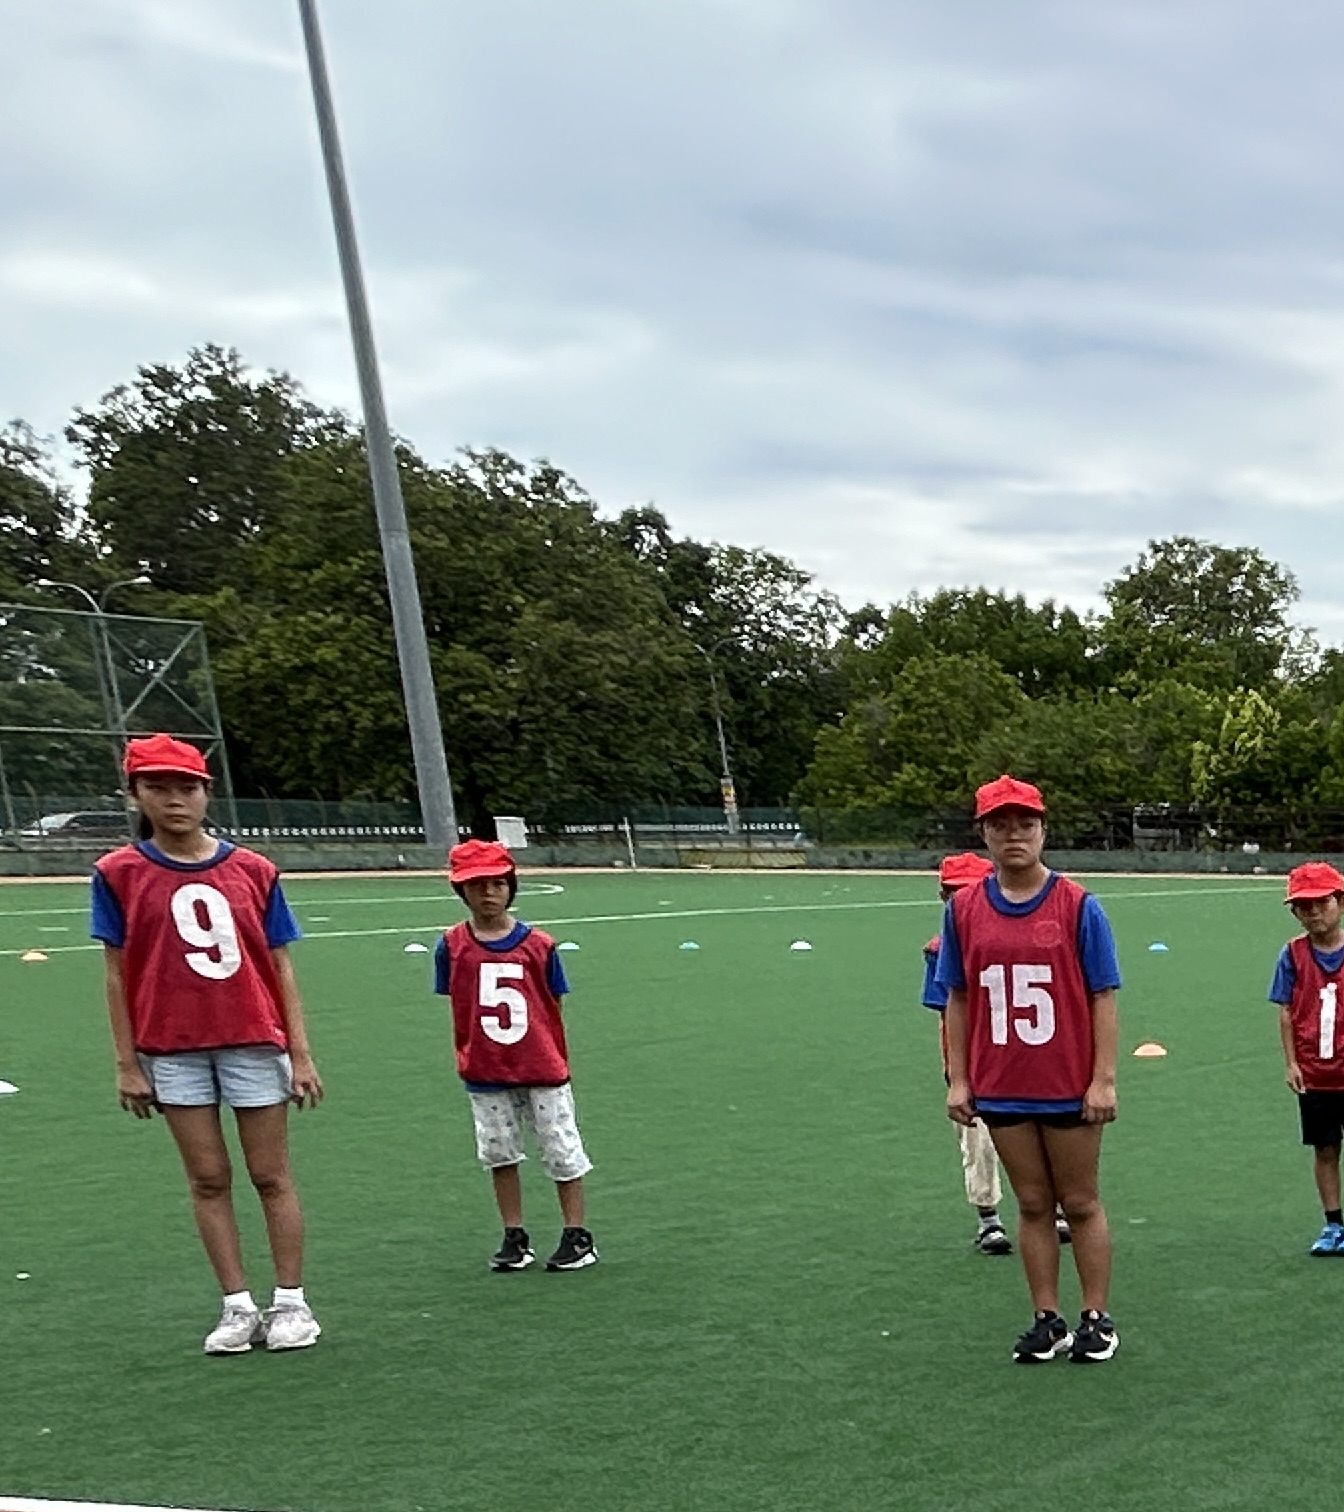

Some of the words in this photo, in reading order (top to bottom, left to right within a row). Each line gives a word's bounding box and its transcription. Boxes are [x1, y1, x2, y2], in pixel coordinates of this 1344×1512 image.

[171, 883, 241, 979] 9
[479, 963, 528, 1045] 5
[980, 965, 1055, 1045] 15
[1319, 983, 1337, 1059] 1
